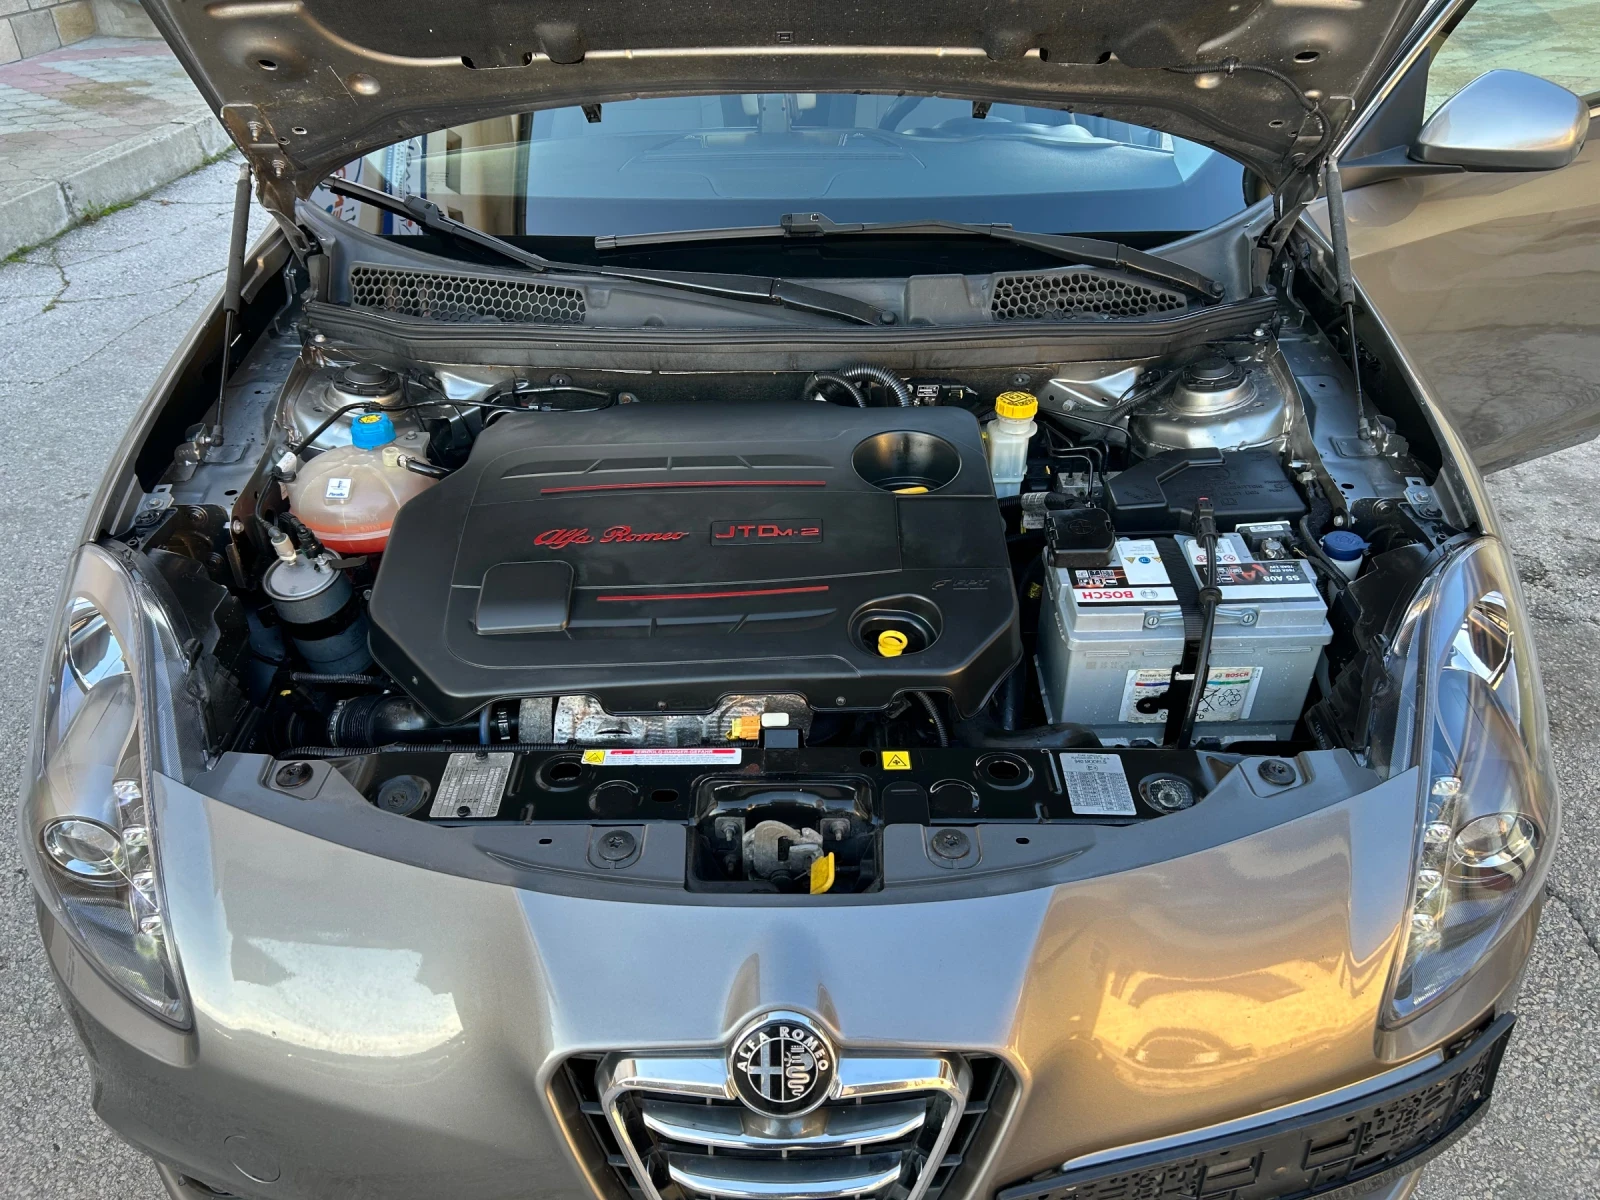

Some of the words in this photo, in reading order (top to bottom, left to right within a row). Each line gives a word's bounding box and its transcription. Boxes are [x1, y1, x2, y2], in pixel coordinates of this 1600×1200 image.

[533, 527, 595, 549] Alfa
[599, 524, 690, 544] Romeo
[1081, 590, 1134, 600] BOSCH
[737, 1031, 771, 1073] ALFA
[779, 1026, 829, 1071] ROMEO
